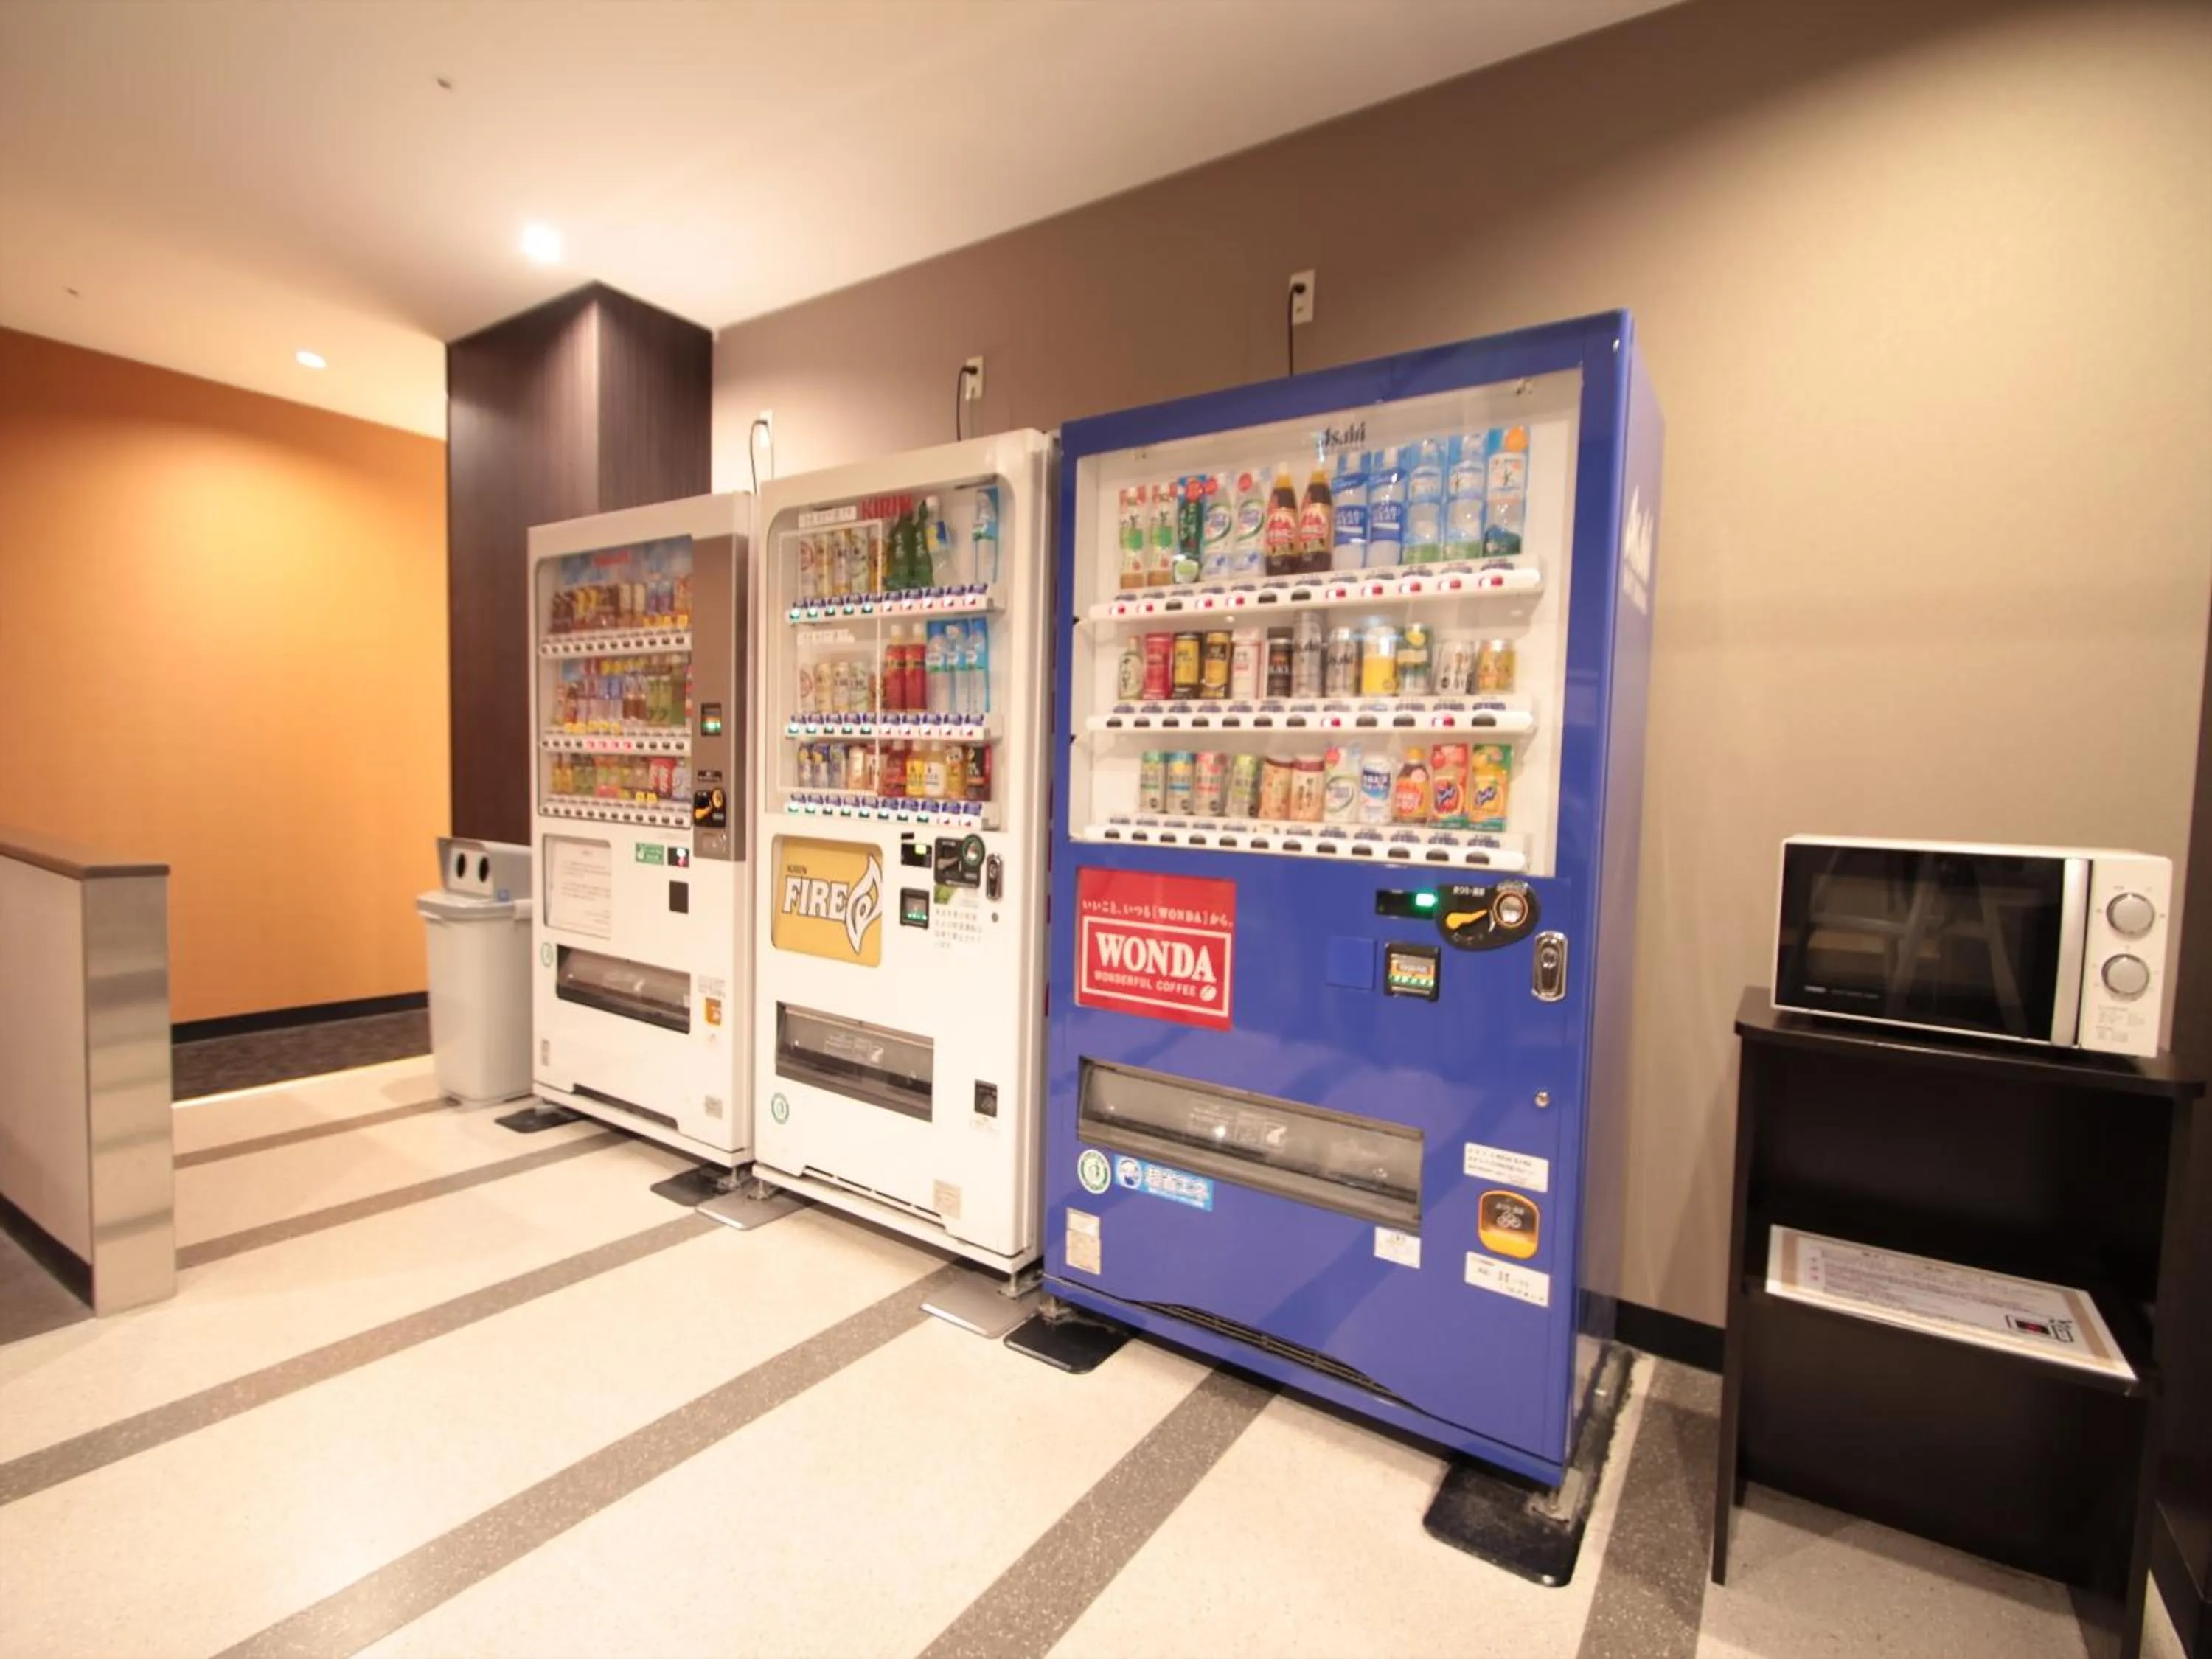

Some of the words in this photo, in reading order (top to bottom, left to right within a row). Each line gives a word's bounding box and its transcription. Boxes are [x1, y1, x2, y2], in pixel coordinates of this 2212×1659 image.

[782, 875, 849, 922] FIRE
[1095, 932, 1217, 983] WONDA
[1093, 970, 1152, 990] WONDERFUL
[1156, 979, 1196, 997] COFFEE
